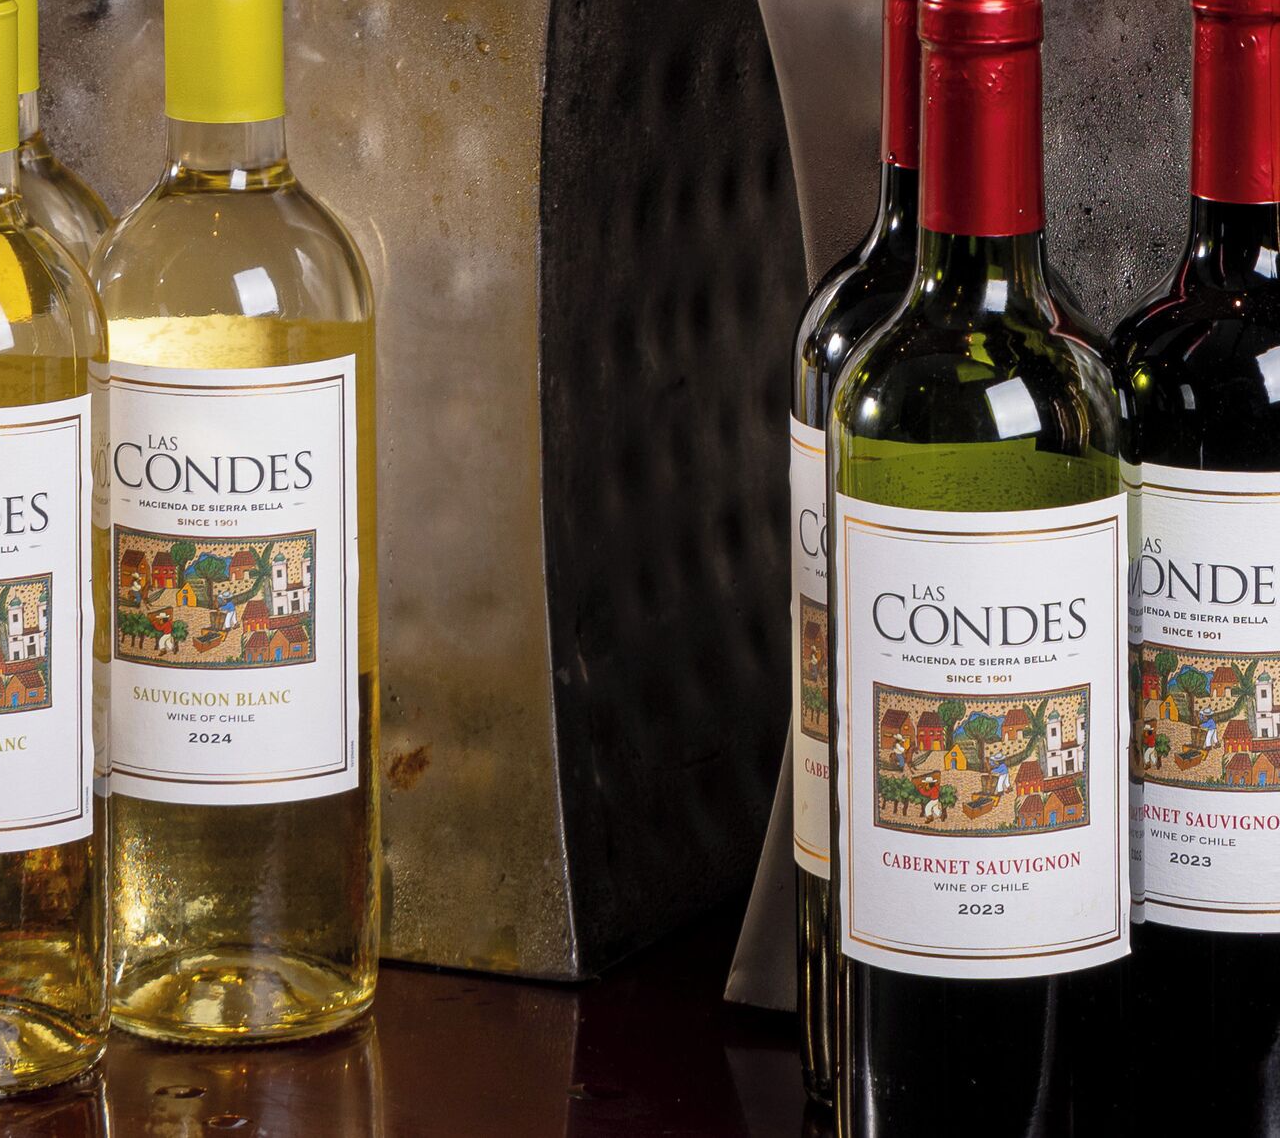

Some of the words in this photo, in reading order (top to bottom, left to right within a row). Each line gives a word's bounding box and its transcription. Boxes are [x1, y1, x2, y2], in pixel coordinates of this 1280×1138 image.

[148, 434, 178, 451] LAS
[114, 442, 313, 494] CONDES
[139, 499, 188, 511] HACIENDA
[191, 504, 205, 512] DE
[209, 504, 247, 512] SIERRA
[251, 502, 283, 511] BELLA
[177, 518, 210, 527] SINCE
[214, 518, 239, 527] 1901
[1141, 536, 1162, 554] AS
[912, 583, 945, 602] LAS
[873, 592, 1087, 647] CONDES
[1143, 605, 1171, 618] IENDA
[1174, 611, 1187, 621] DE
[1190, 613, 1230, 624] SIERRA
[1233, 615, 1269, 625] BELLA
[1162, 626, 1193, 638] SINCE
[1197, 630, 1222, 640] 1901
[902, 654, 957, 666] HACIENDA
[960, 657, 976, 667] DE
[979, 657, 1021, 667] SIERRA
[1024, 654, 1057, 665] BELLA
[946, 674, 983, 684] SINCE
[986, 674, 1013, 684] 1901
[133, 686, 230, 707] SAUVIGNON
[236, 689, 292, 707] BLANC
[166, 712, 197, 722] WINE
[200, 714, 216, 723] OF
[219, 713, 256, 723] CHILE
[188, 732, 233, 744] 2024
[804, 757, 830, 780] CABE
[1143, 804, 1181, 826] RNET
[1150, 828, 1177, 842] WINE
[1180, 834, 1197, 844] OF
[1199, 836, 1237, 847] CHILE
[882, 851, 970, 875] CABERNET
[976, 851, 1081, 876] SAUVIGNON
[1169, 852, 1212, 868] 2023
[933, 881, 967, 893] WINE
[970, 883, 988, 893] OF
[991, 882, 1030, 892] CHILE
[958, 903, 1005, 915] 2023
